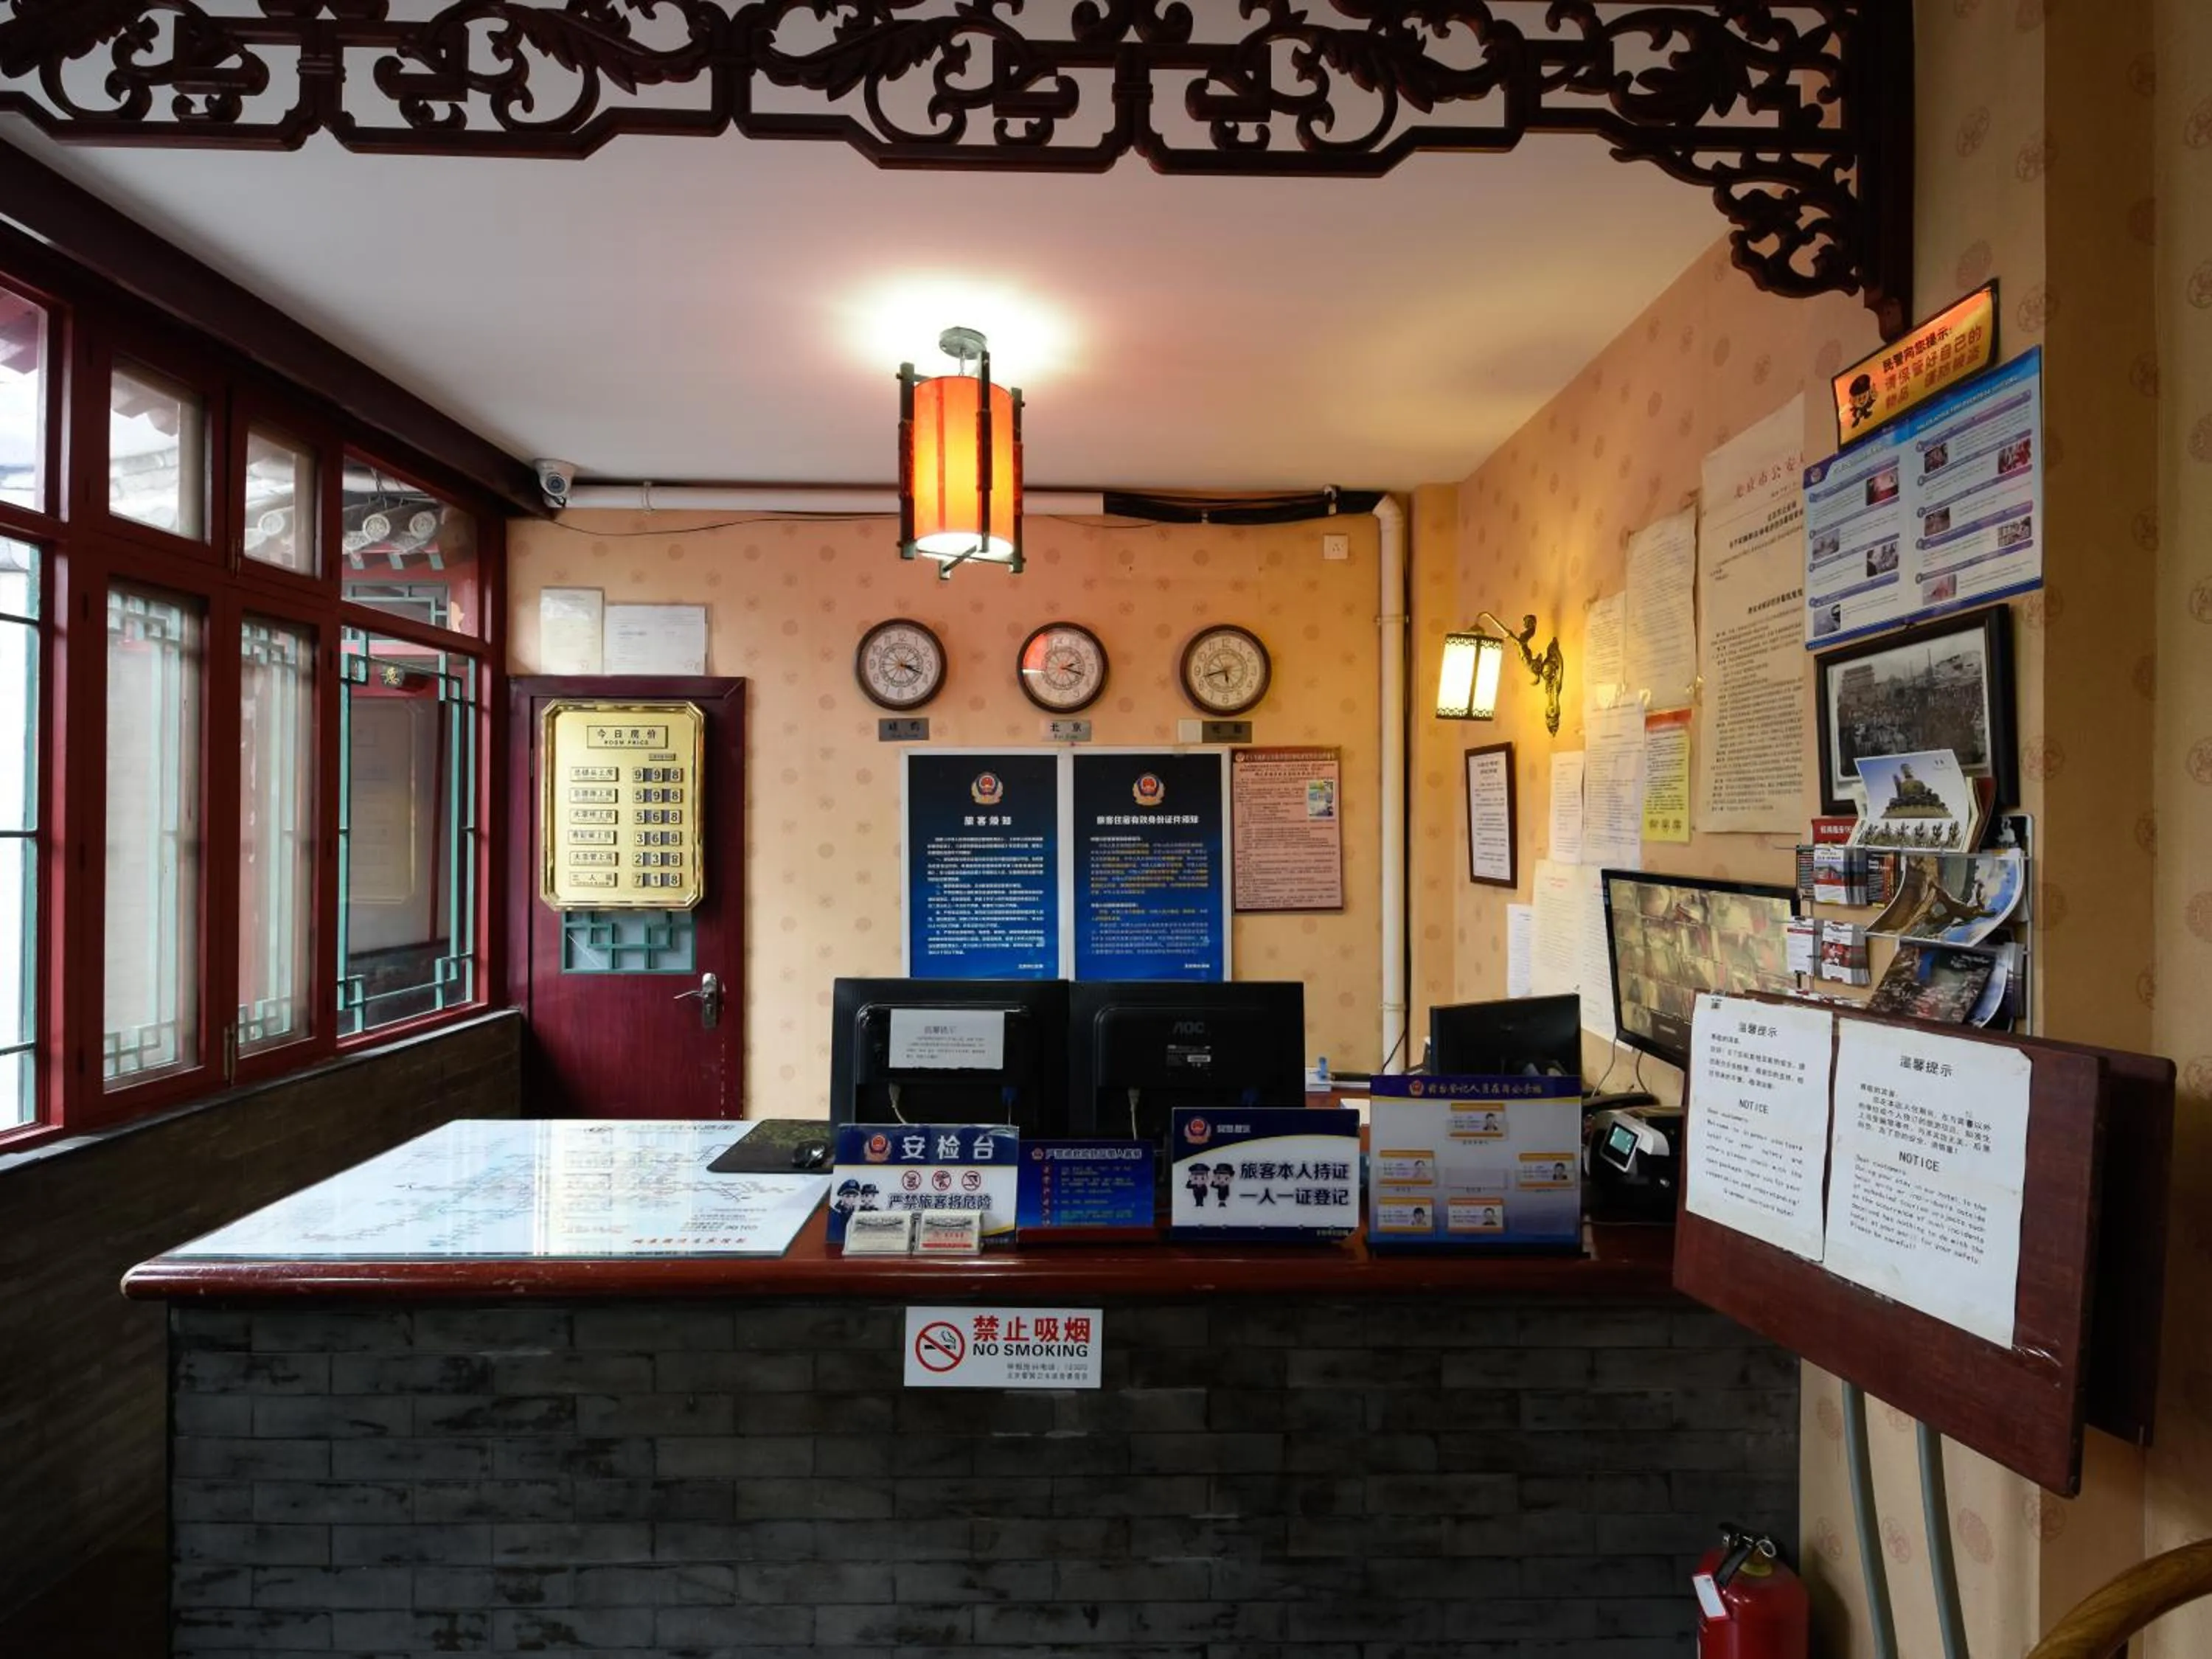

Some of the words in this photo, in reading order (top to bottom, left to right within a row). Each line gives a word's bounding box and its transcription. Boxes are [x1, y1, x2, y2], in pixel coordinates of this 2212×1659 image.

[597, 728, 655, 739] 今日房价
[1050, 723, 1082, 732] 北京
[635, 769, 679, 780] 998
[635, 790, 679, 801] 598
[636, 811, 678, 822] 568
[636, 833, 678, 844] 368
[635, 875, 678, 885] 718
[1172, 1022, 1204, 1034] AOC
[1899, 1054, 1953, 1077] 温馨提示
[1739, 1099, 1769, 1114] NOTICE
[900, 1135, 995, 1160] 安检台
[1898, 1150, 1940, 1172] NOTICE
[1240, 1162, 1349, 1180] 旅客本人持证
[1239, 1188, 1349, 1206] 一人一证登记
[973, 1315, 1091, 1343] 禁止吸烟
[973, 1343, 998, 1356] NO
[1004, 1344, 1088, 1357] SMOKING
